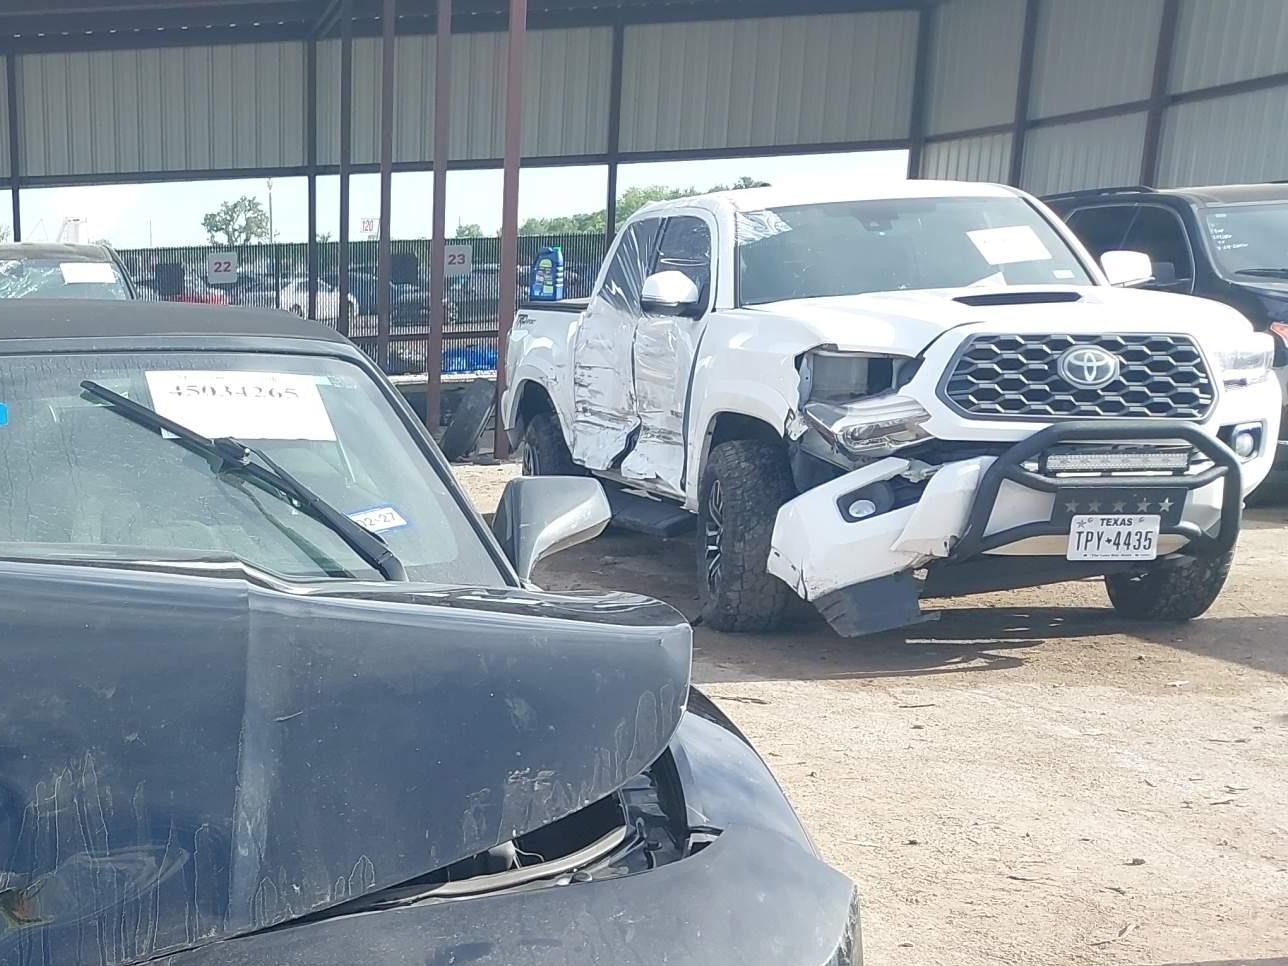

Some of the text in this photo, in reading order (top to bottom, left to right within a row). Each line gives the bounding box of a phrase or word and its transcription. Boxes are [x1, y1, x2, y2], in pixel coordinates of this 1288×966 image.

[447, 254, 466, 265] 23
[213, 261, 232, 272] 22
[169, 384, 299, 399] 45034265
[1100, 517, 1133, 527] TEXAS
